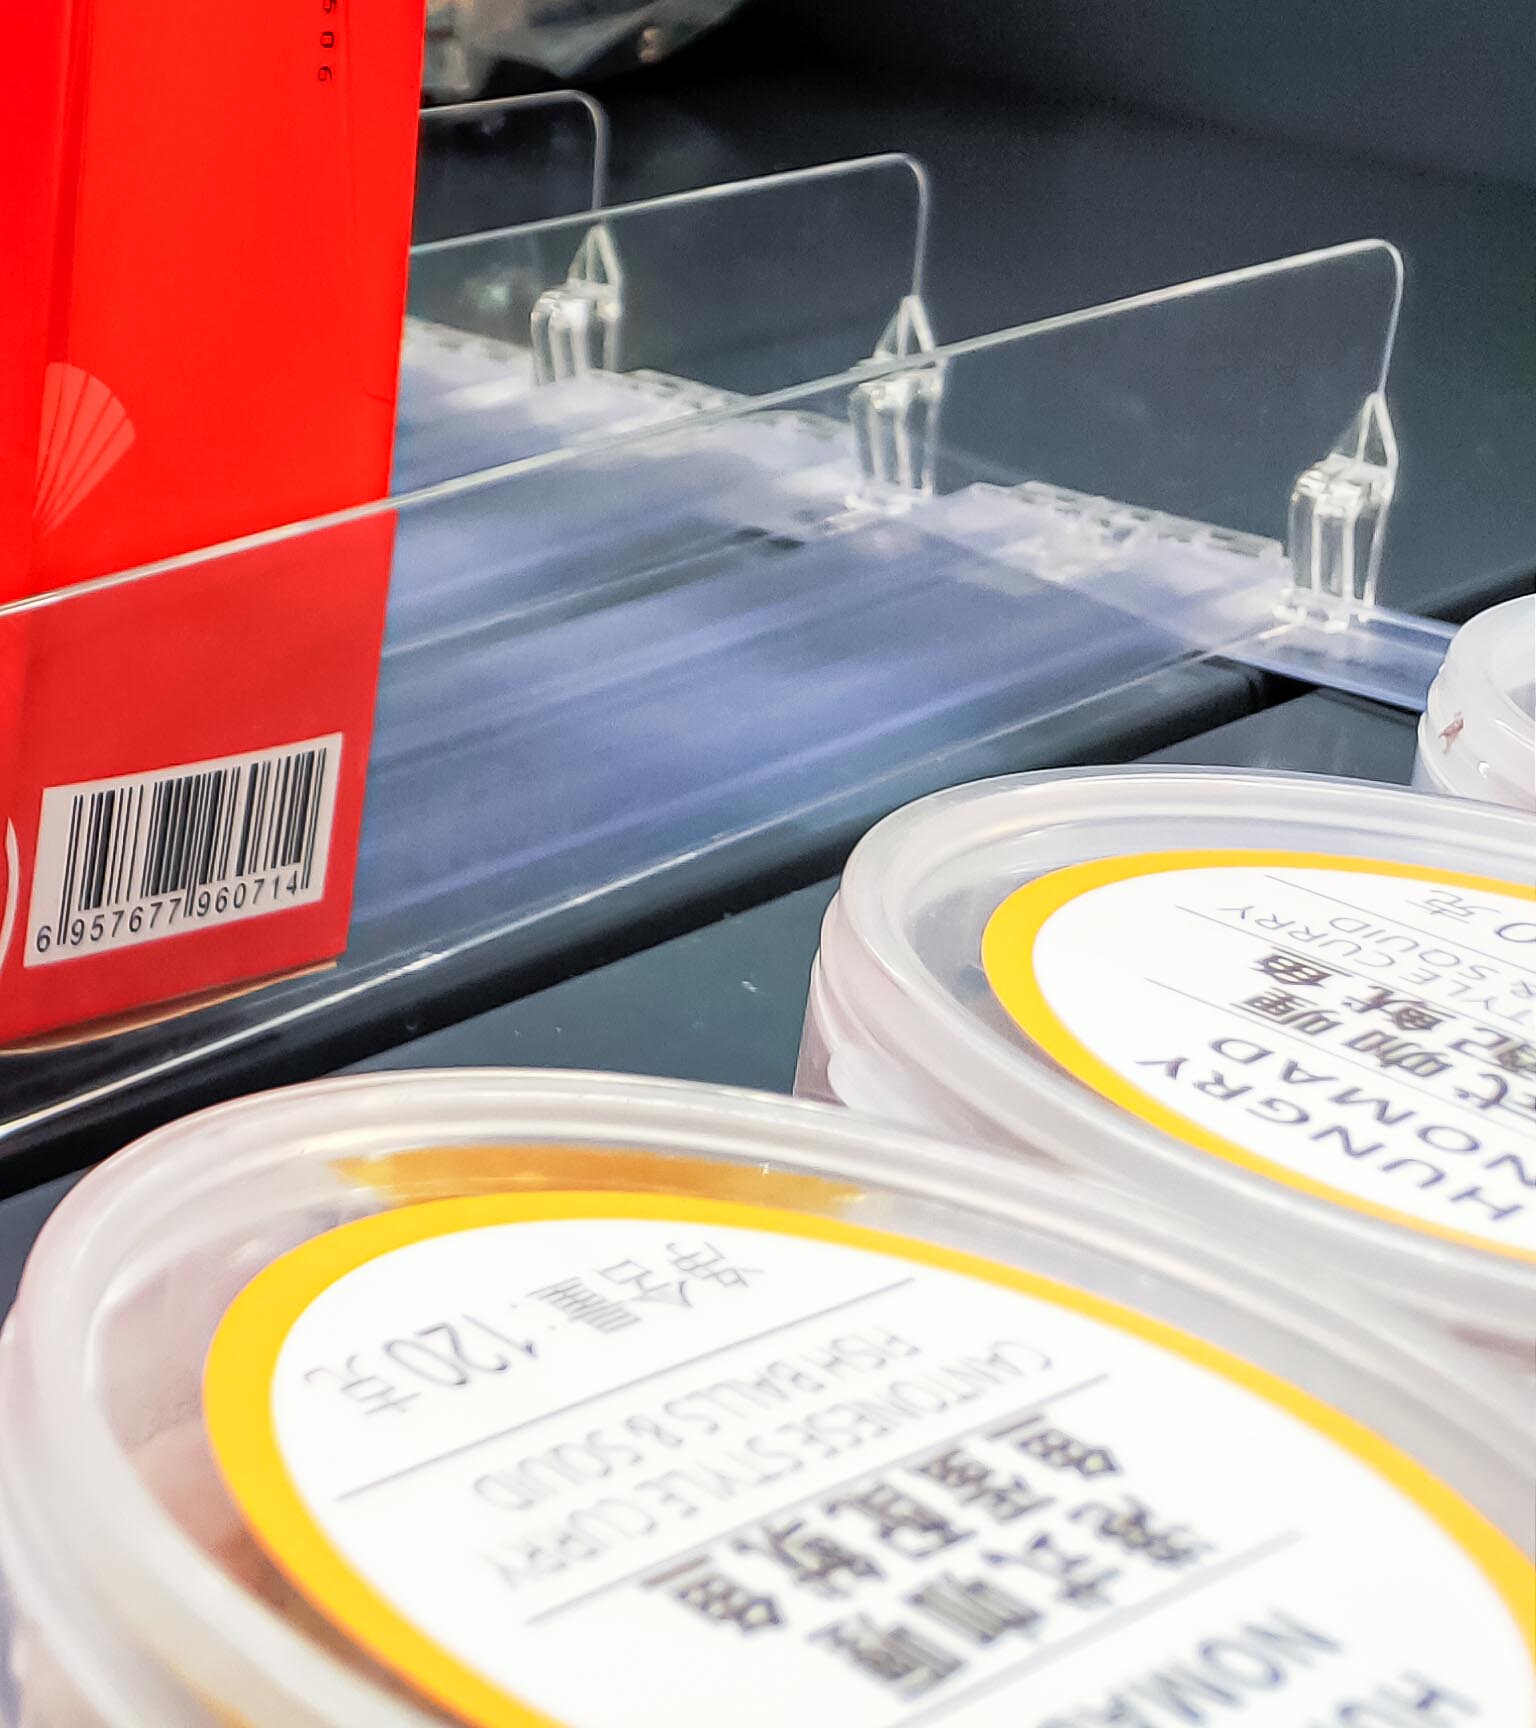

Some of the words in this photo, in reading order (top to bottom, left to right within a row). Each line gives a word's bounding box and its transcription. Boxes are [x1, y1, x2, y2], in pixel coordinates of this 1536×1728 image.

[1216, 904, 1397, 969] CURRY
[1328, 915, 1501, 983] SQUID
[1134, 1055, 1526, 1222] HUNGRY
[1209, 1037, 1536, 1189] NOMAD
